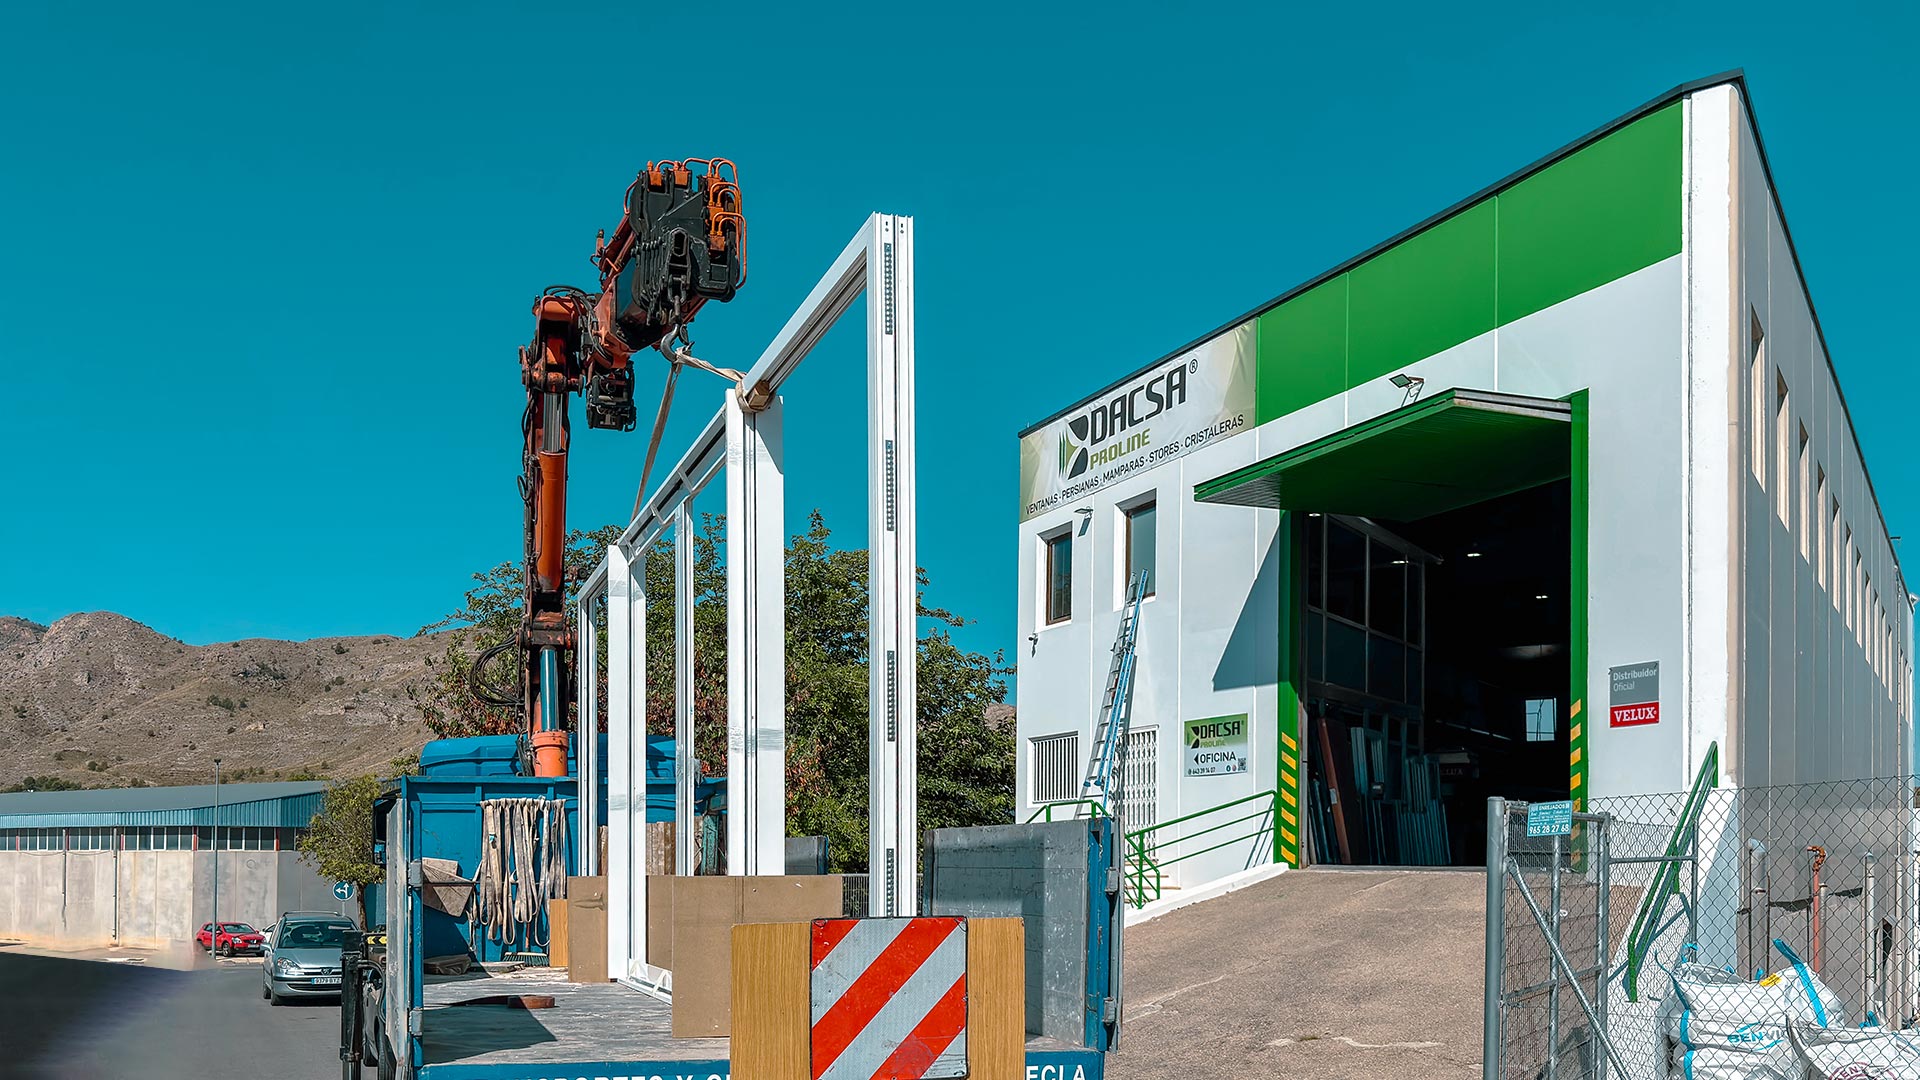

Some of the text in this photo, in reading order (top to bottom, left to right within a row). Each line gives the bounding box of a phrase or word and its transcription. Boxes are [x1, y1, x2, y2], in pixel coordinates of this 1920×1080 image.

[1090, 428, 1151, 470] PROLINE
[1025, 414, 1244, 515] VENTANAS PERSIANAS MAMPARAS STORES CRISTALERAS
[1613, 668, 1657, 681] Distribuidor
[1613, 681, 1635, 692] Oficial
[1614, 706, 1656, 722] VELUX
[1200, 751, 1236, 764] OFICINA
[1529, 825, 1541, 834] 965
[1551, 824, 1560, 833] 27
